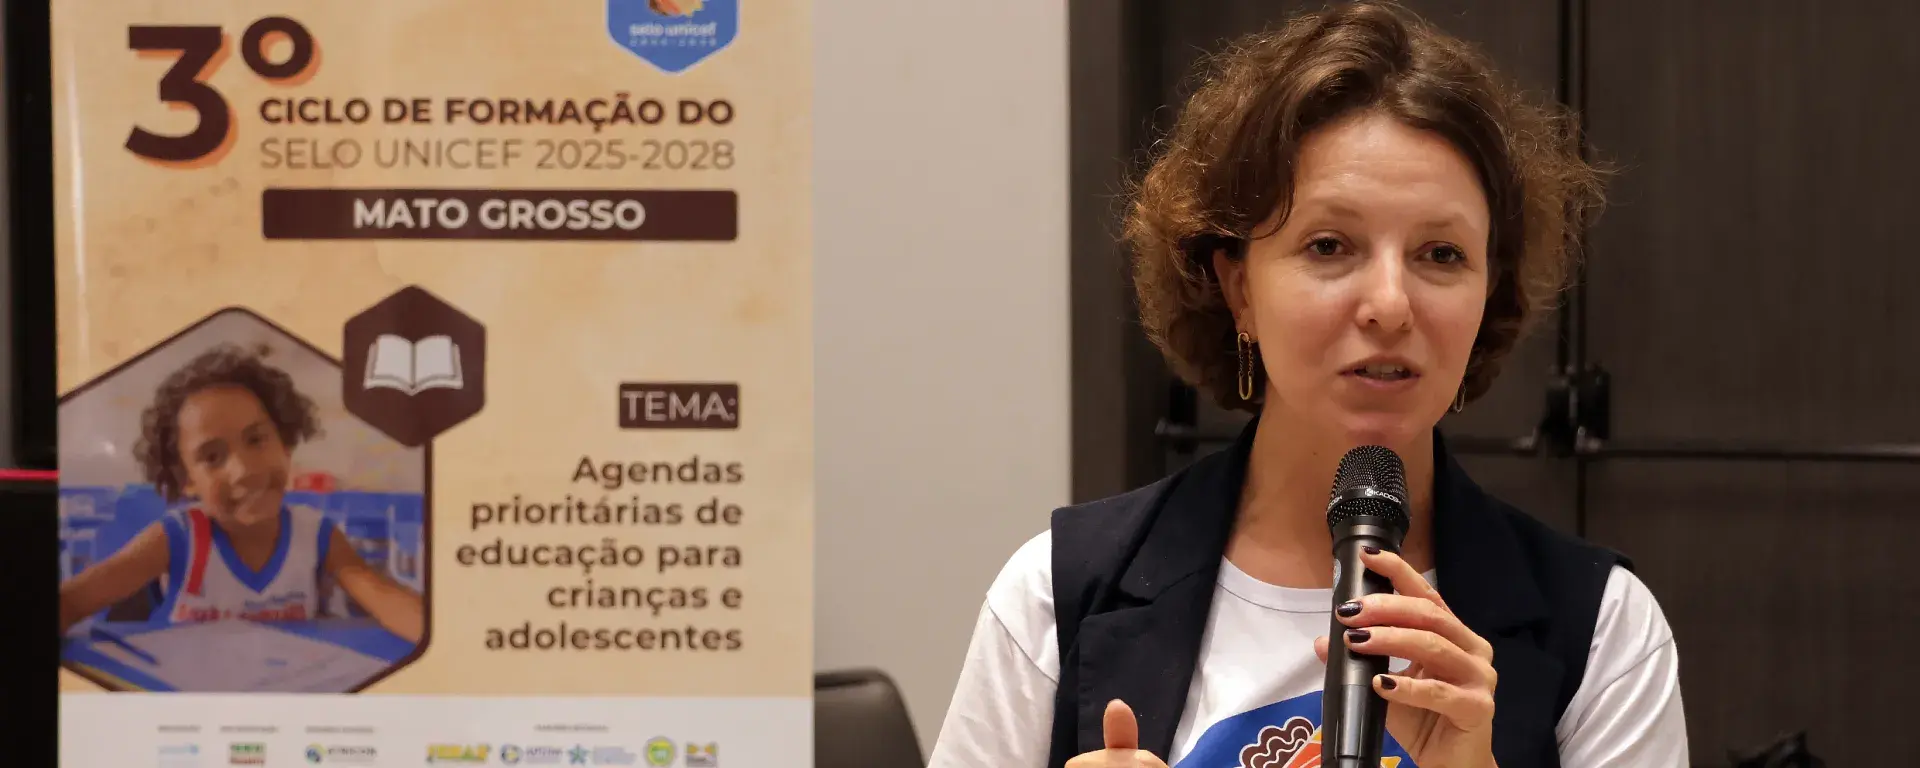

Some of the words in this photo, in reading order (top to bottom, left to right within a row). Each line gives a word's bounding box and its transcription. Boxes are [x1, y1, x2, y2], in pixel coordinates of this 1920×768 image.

[260, 98, 370, 124] CICLO
[384, 98, 432, 123] DE
[445, 91, 664, 133] FORMAÇÃO
[679, 98, 735, 124] DO
[260, 138, 362, 169] SELO
[374, 138, 523, 170] UNICEF
[536, 138, 735, 170] 2025-2028
[353, 199, 469, 229] MATO
[478, 198, 646, 230] GROSSO
[622, 391, 737, 422] TEMA:
[572, 456, 743, 490] Agendas
[470, 495, 684, 530] prioritárias
[696, 498, 743, 525] de
[455, 538, 645, 575] educação
[657, 545, 742, 573] para
[547, 579, 709, 616] crianças
[720, 586, 743, 609] e
[485, 620, 743, 651] adolescentes
